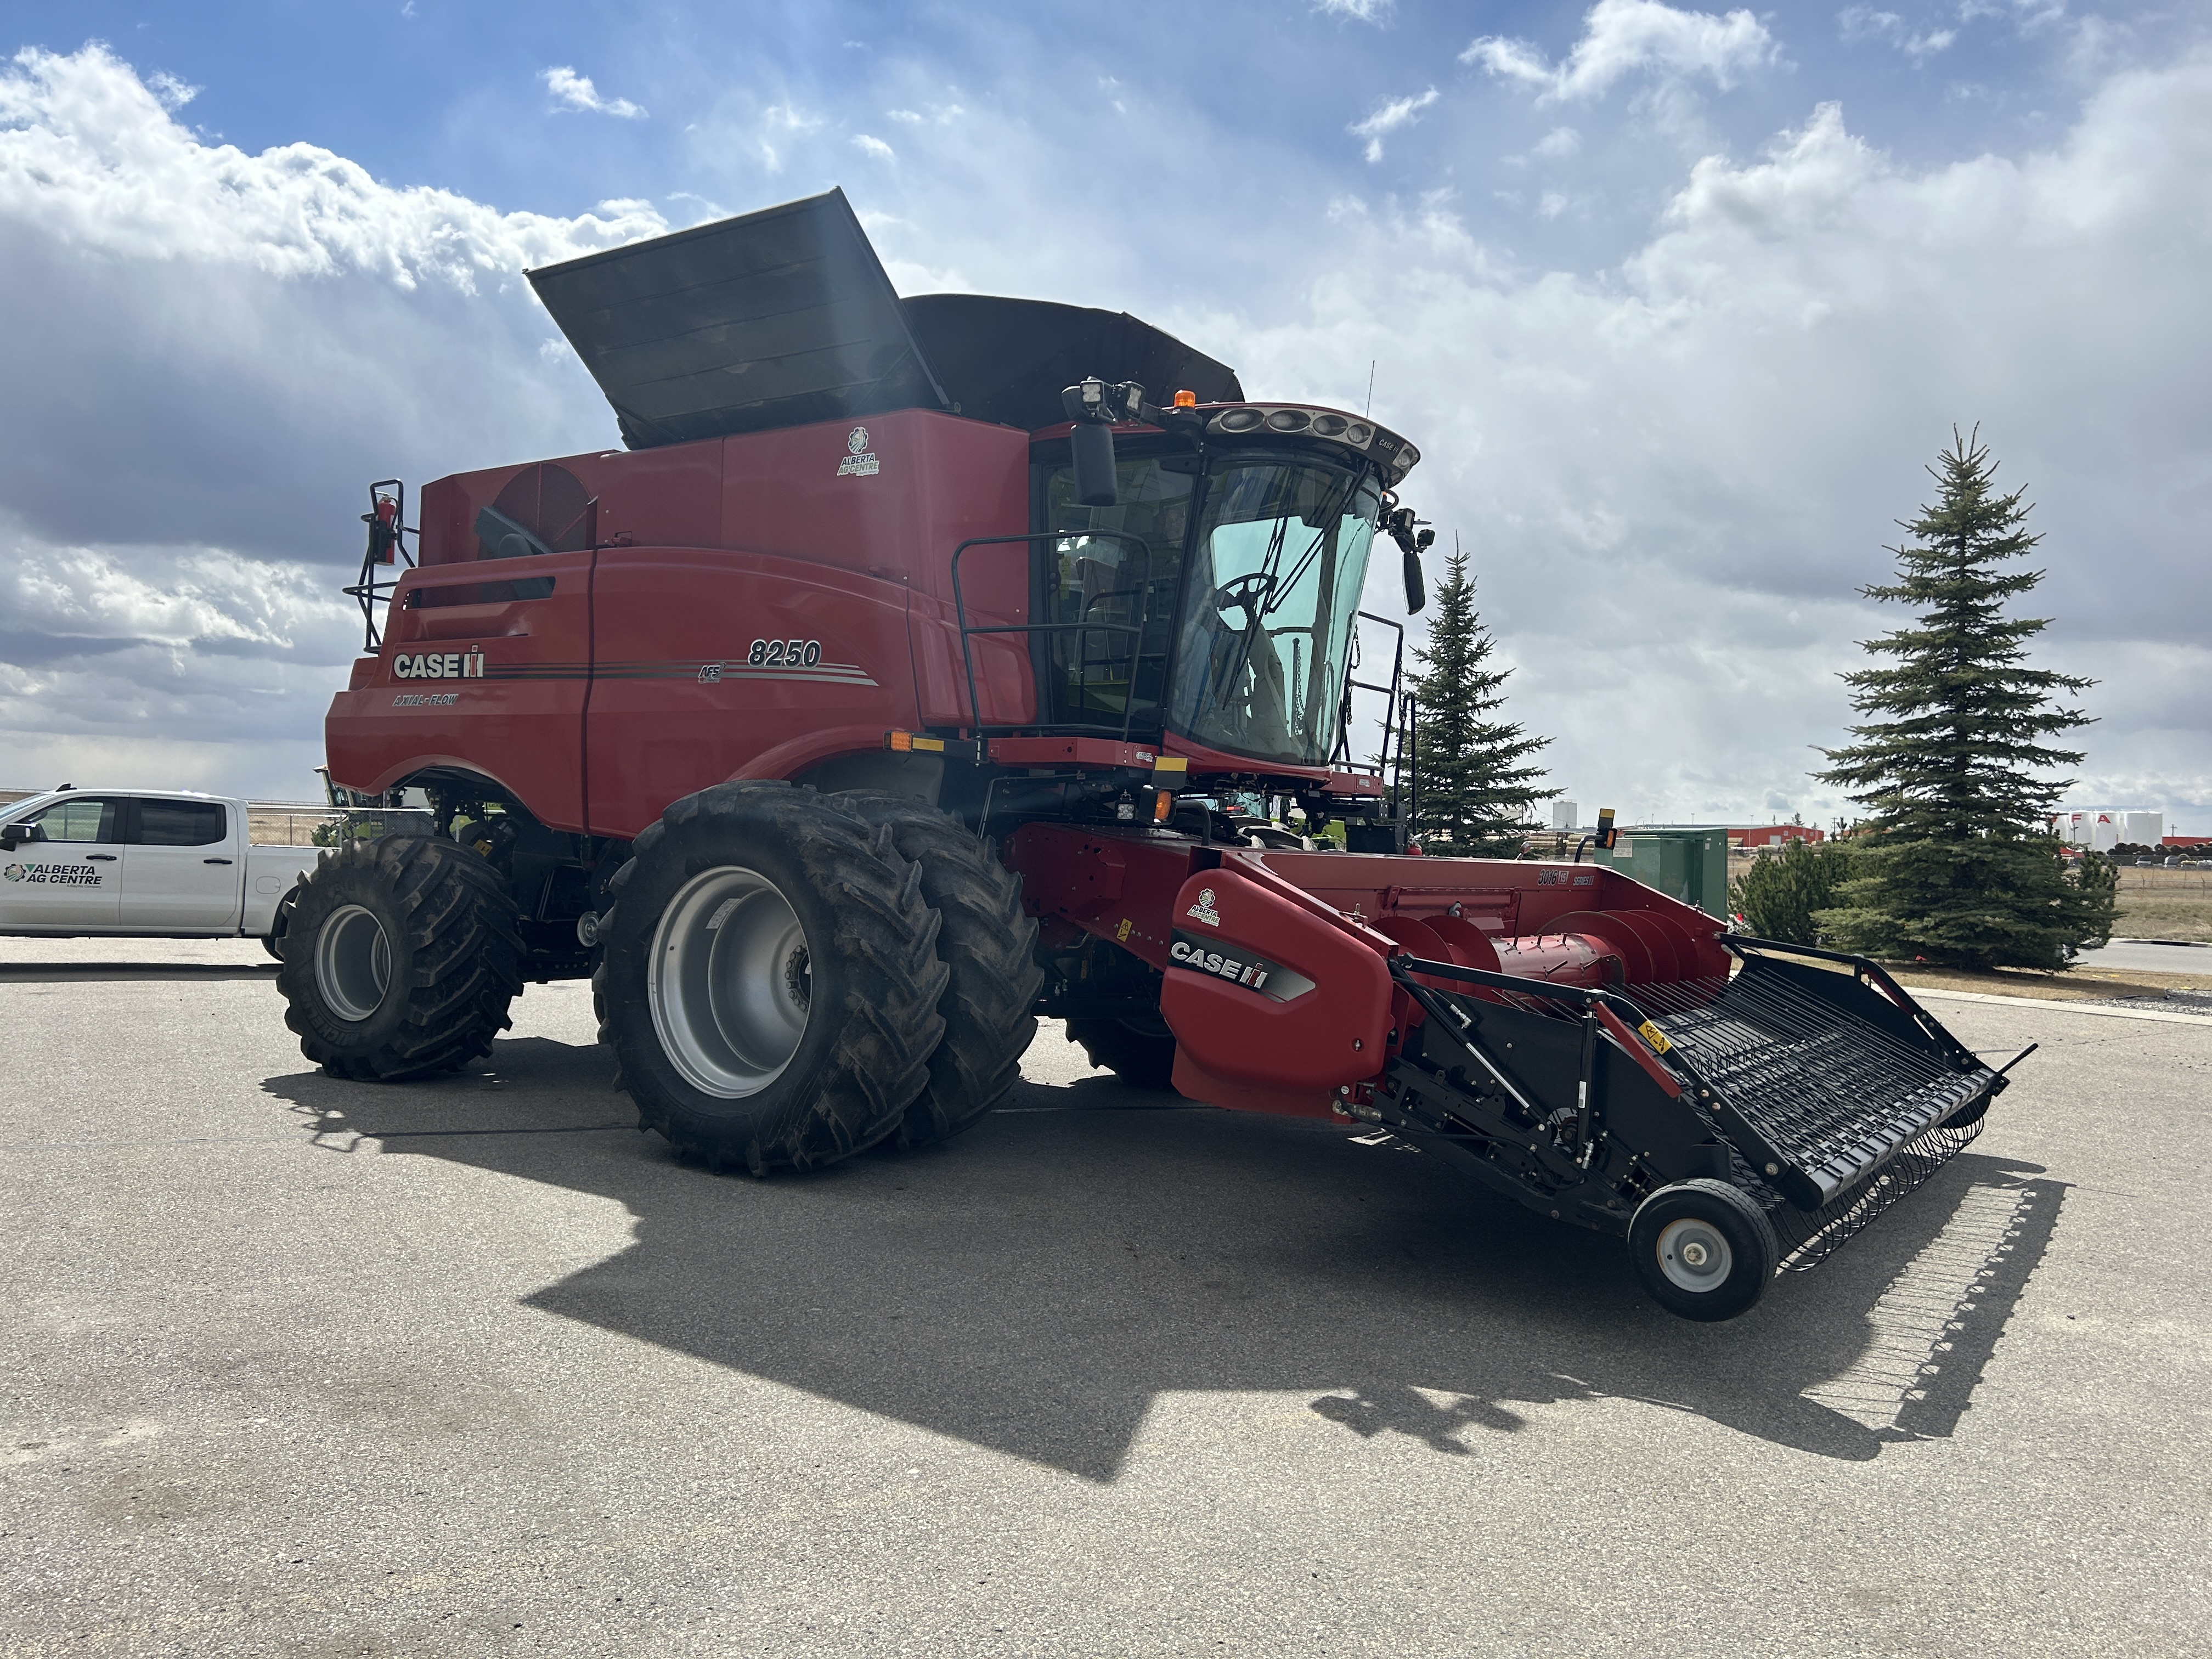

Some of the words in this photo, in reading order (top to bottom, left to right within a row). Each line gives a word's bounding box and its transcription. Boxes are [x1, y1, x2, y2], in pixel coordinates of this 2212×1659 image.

[1379, 439, 1394, 450] CASE
[842, 454, 874, 466] ALBERTA
[838, 466, 849, 474] AG
[850, 462, 878, 473] CENTRE
[748, 639, 822, 669] 8250
[393, 653, 460, 679] CASE
[698, 665, 721, 678] AFS
[392, 693, 459, 707] AXIAL-FLOW
[33, 864, 95, 875] ALBERTA
[26, 874, 47, 883] AG
[49, 875, 103, 884] CENTRE
[1538, 869, 1558, 886] 3016
[1573, 876, 1589, 886] SERIES
[1192, 905, 1217, 917] ALBERTA
[1197, 912, 1220, 923] CENTRE
[1171, 941, 1242, 979] CASE
